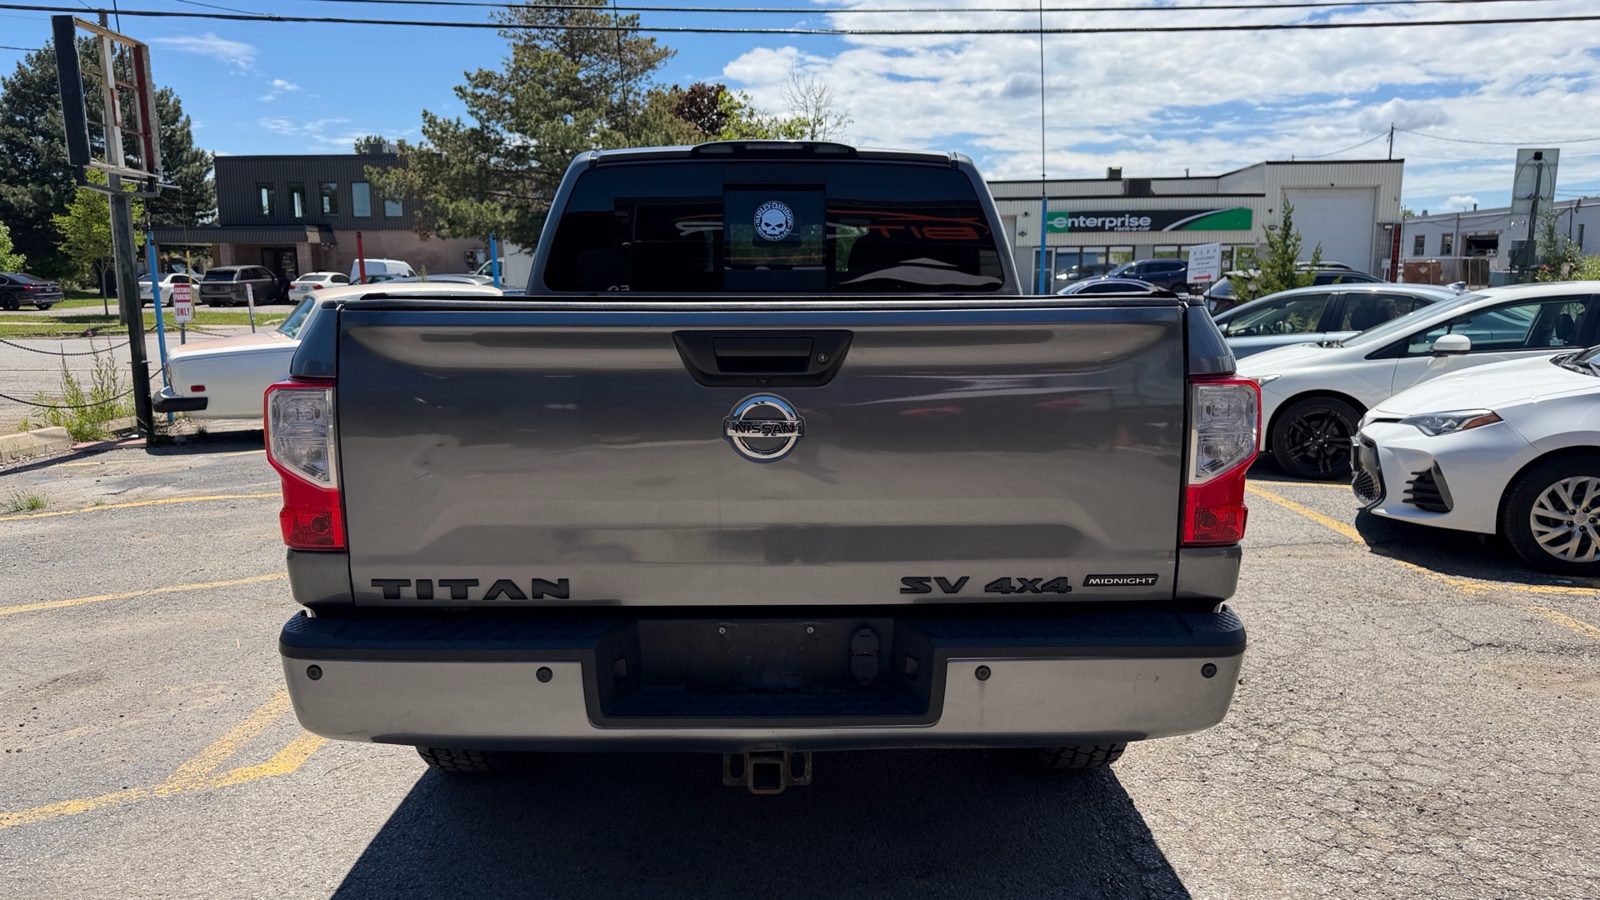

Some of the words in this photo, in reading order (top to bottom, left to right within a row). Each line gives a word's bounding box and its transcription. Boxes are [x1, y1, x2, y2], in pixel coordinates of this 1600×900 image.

[1051, 214, 1151, 230] enterprise
[176, 307, 190, 317] ONLY
[735, 422, 796, 435] NISSAN
[370, 577, 570, 600] TITAN
[899, 576, 970, 594] SV
[1088, 577, 1155, 586] MIDNIGHT
